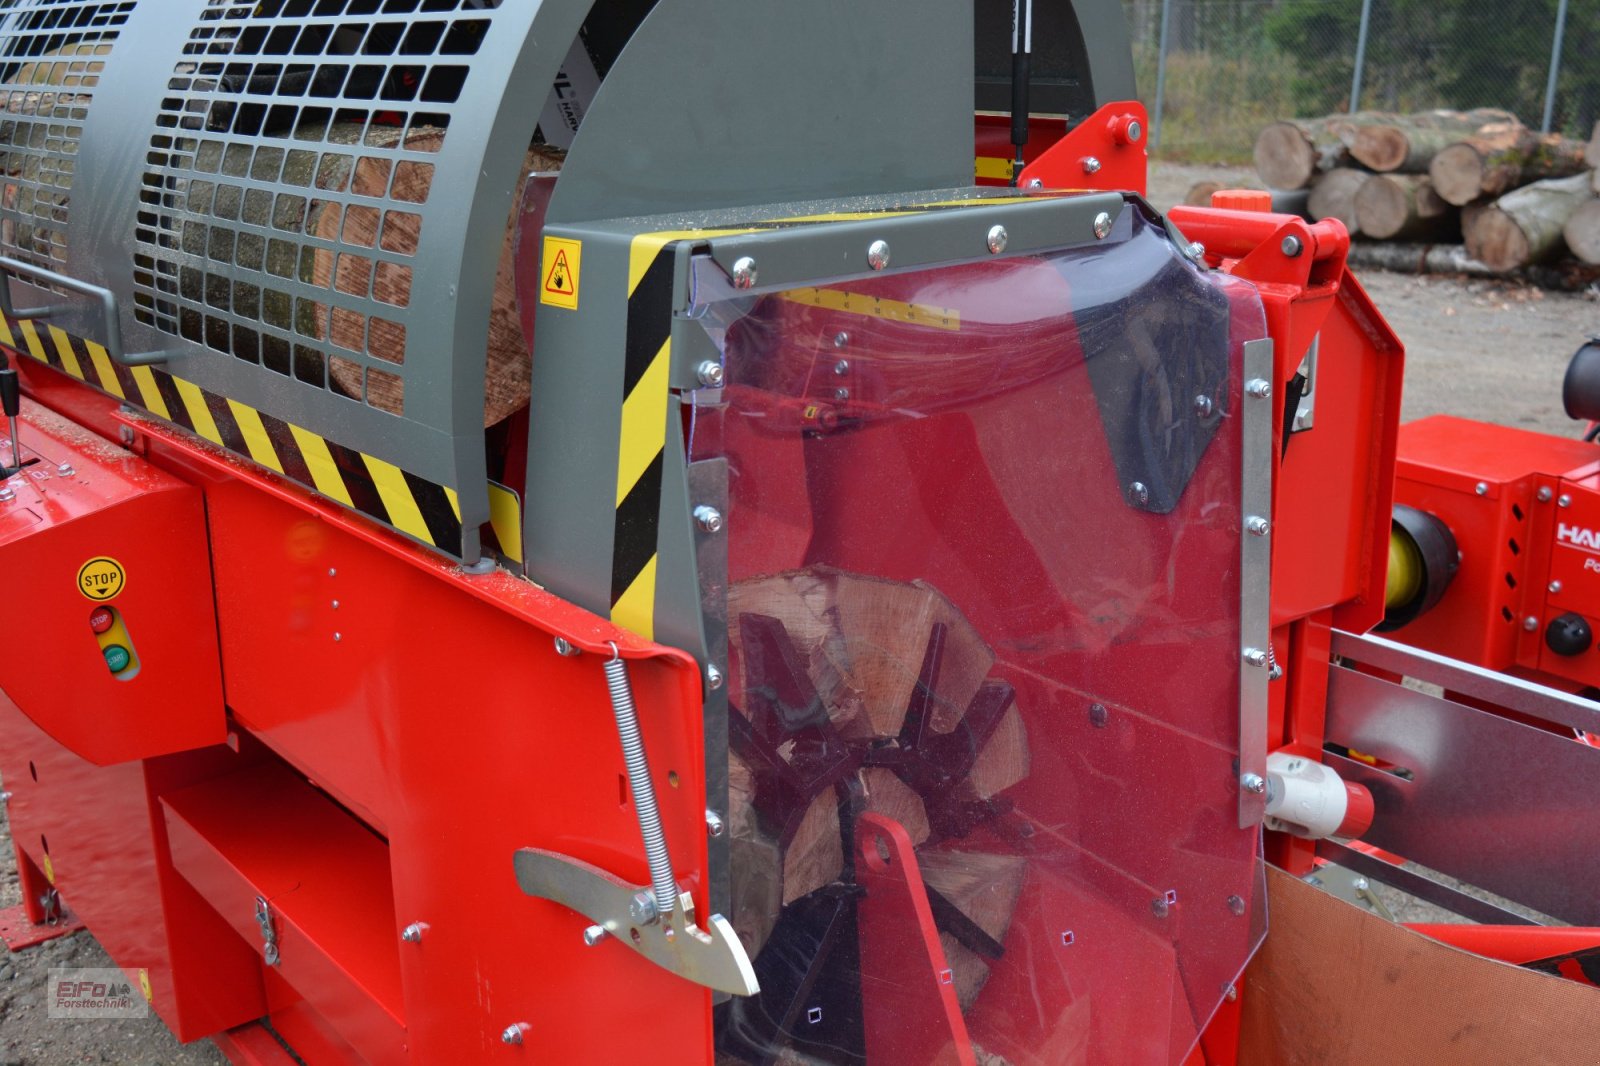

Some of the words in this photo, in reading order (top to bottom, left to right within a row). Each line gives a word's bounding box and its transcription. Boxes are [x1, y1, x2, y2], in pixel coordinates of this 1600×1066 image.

[85, 572, 117, 586] STOP
[91, 614, 108, 626] STOP
[108, 653, 124, 666] START
